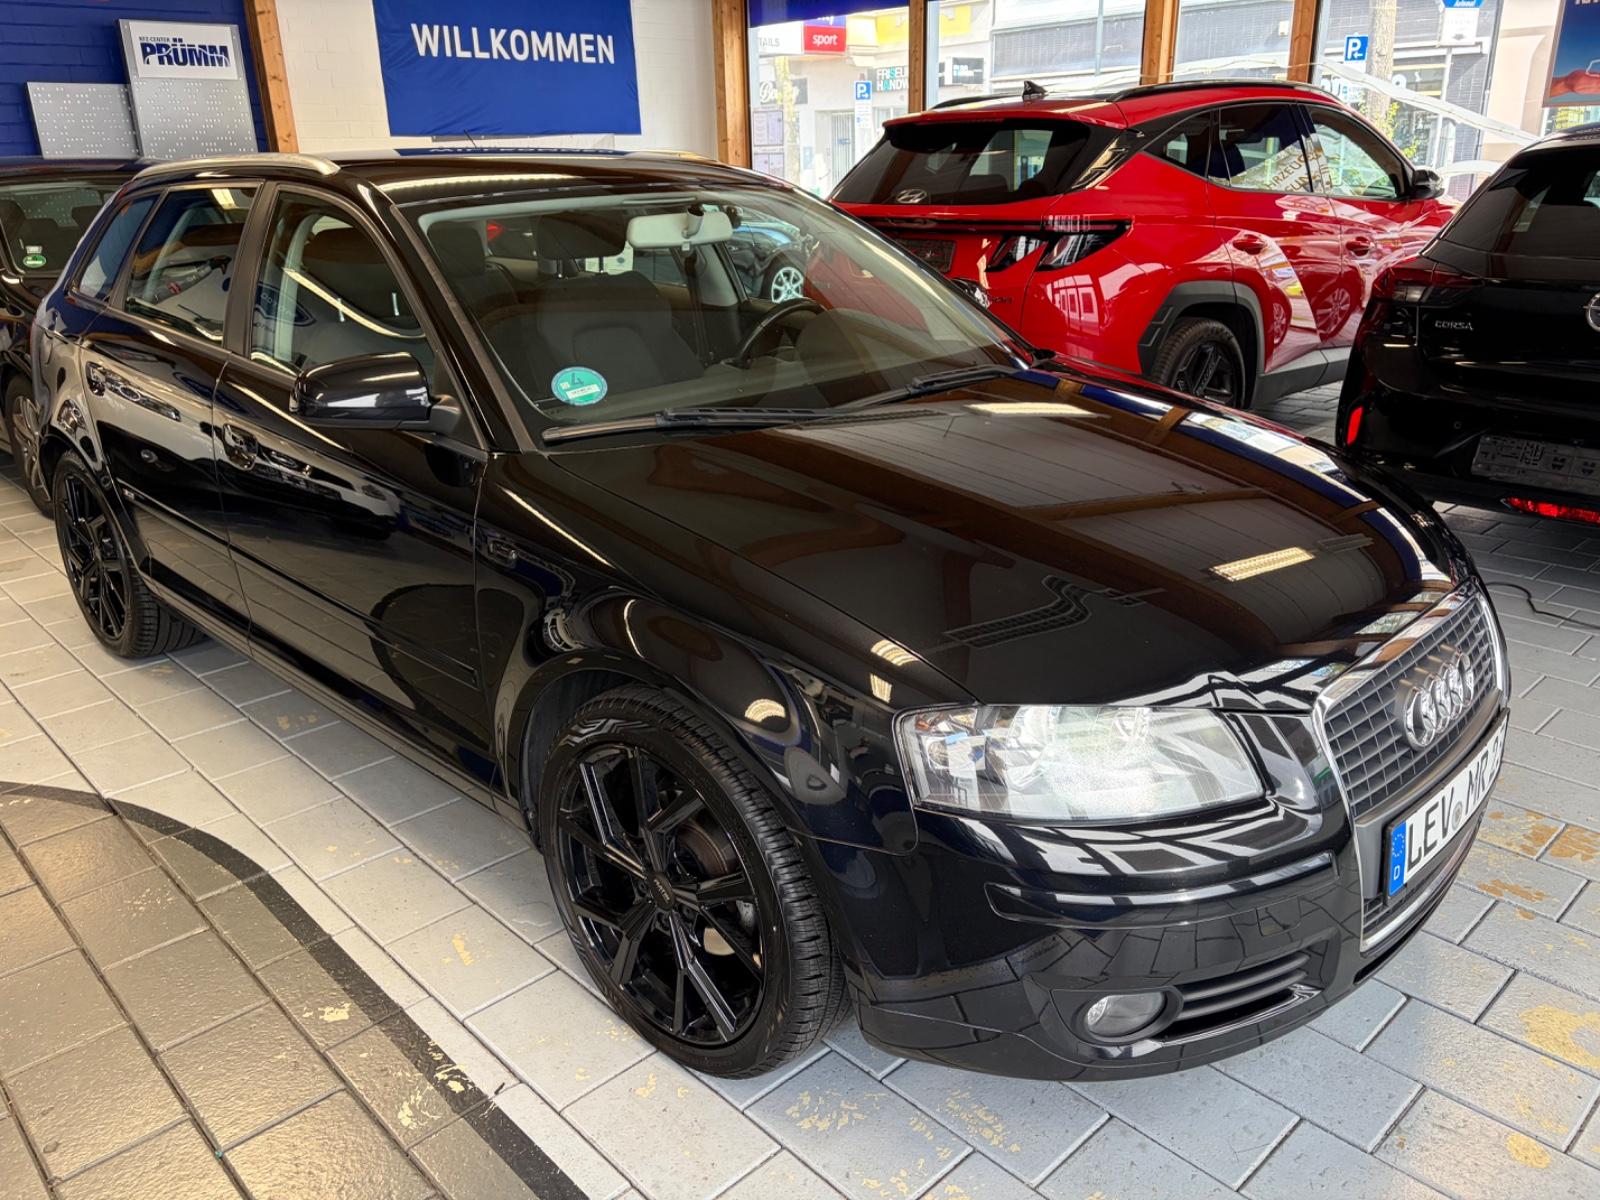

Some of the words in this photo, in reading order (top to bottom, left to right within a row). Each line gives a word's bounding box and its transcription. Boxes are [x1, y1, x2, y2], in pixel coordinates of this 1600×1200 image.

[411, 23, 615, 64] WILLKOMMEN
[812, 34, 838, 46] sport
[140, 38, 231, 67] PRÜMM
[1435, 320, 1473, 331] CORSA
[1407, 786, 1455, 872] LEV
[1465, 748, 1489, 816] MR
[1393, 865, 1401, 881] D
